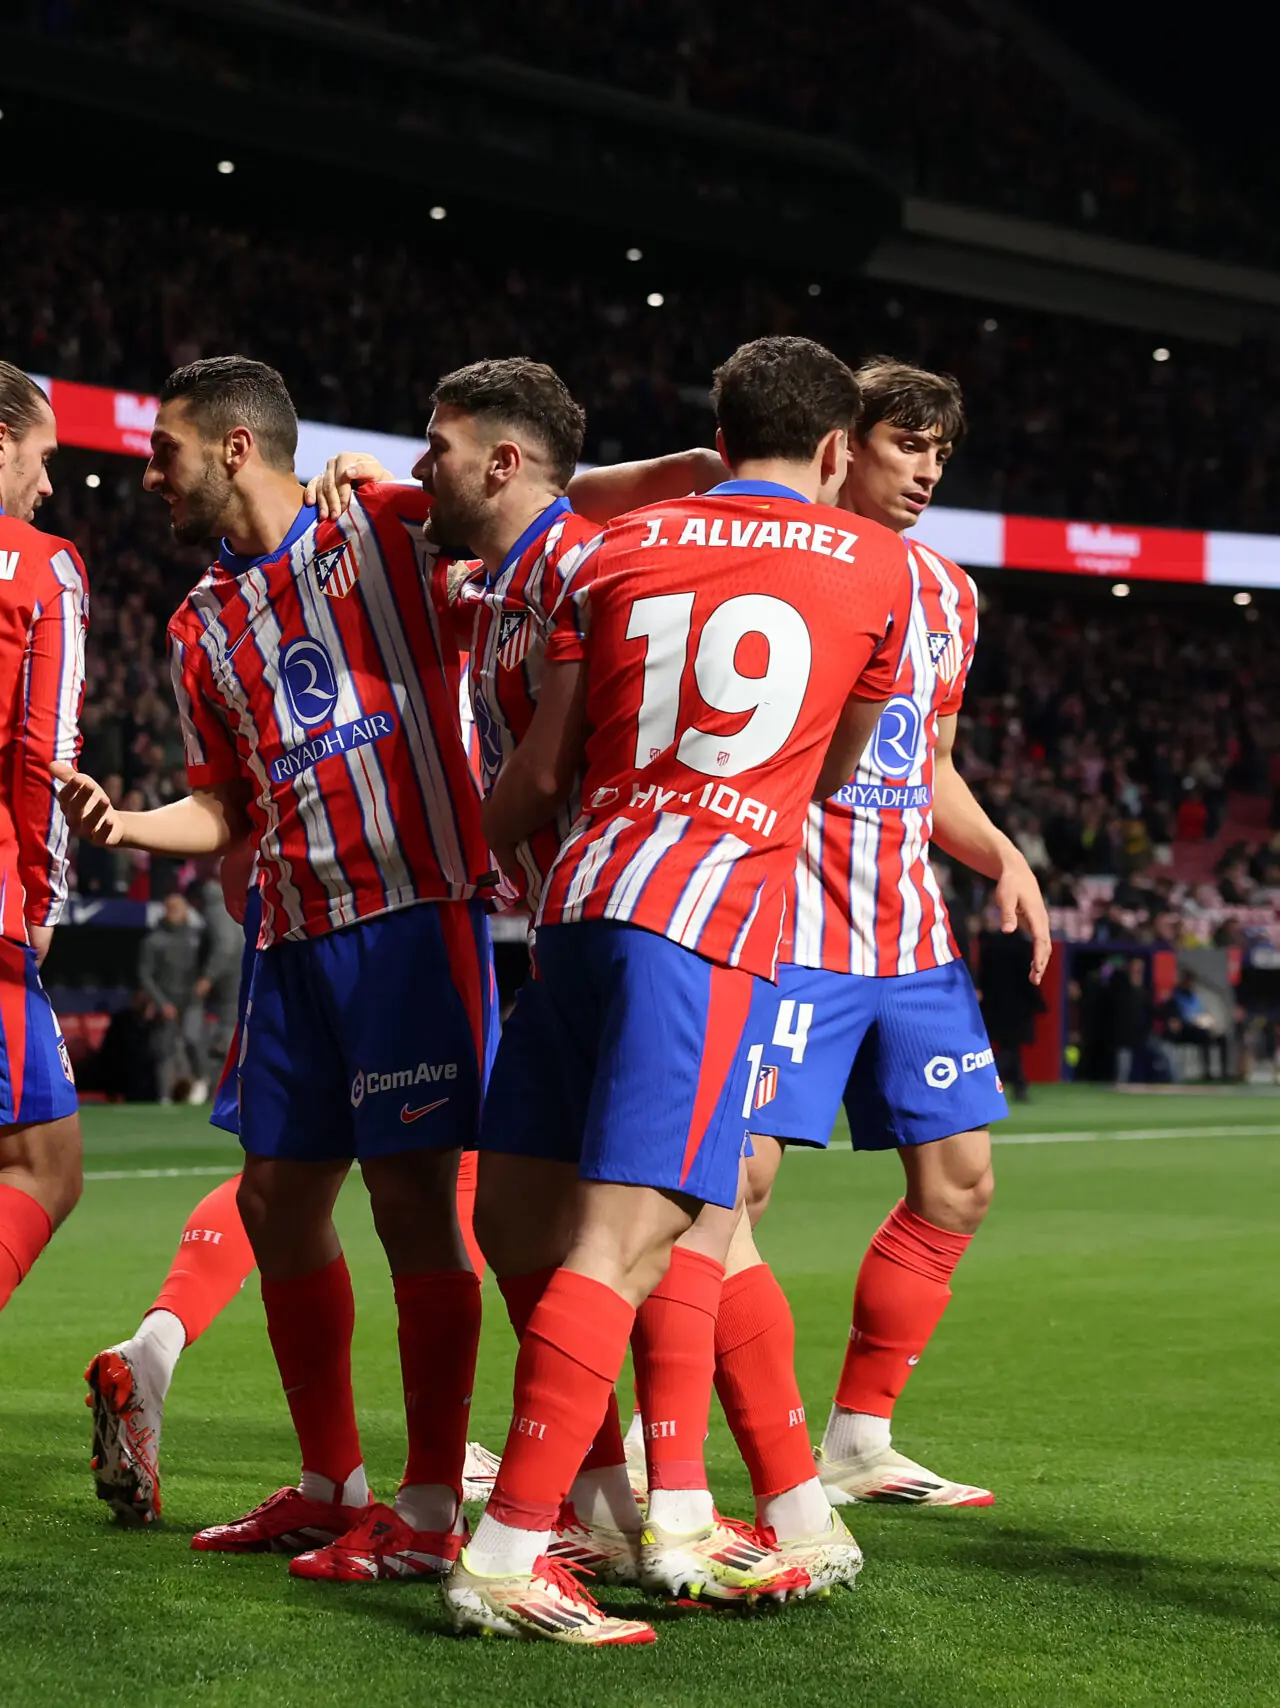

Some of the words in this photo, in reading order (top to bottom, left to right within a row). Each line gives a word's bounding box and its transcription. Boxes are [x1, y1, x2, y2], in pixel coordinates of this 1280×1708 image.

[640, 520, 668, 548] J.
[678, 518, 859, 564] ALVAREZ
[625, 591, 813, 778] 19
[274, 730, 345, 780] RIYADH
[352, 715, 391, 745] AIR
[837, 784, 910, 807] RIYADH
[910, 786, 929, 806] AIR
[771, 999, 815, 1064] 4
[366, 1062, 457, 1093] ComAve
[742, 1044, 764, 1120] 1
